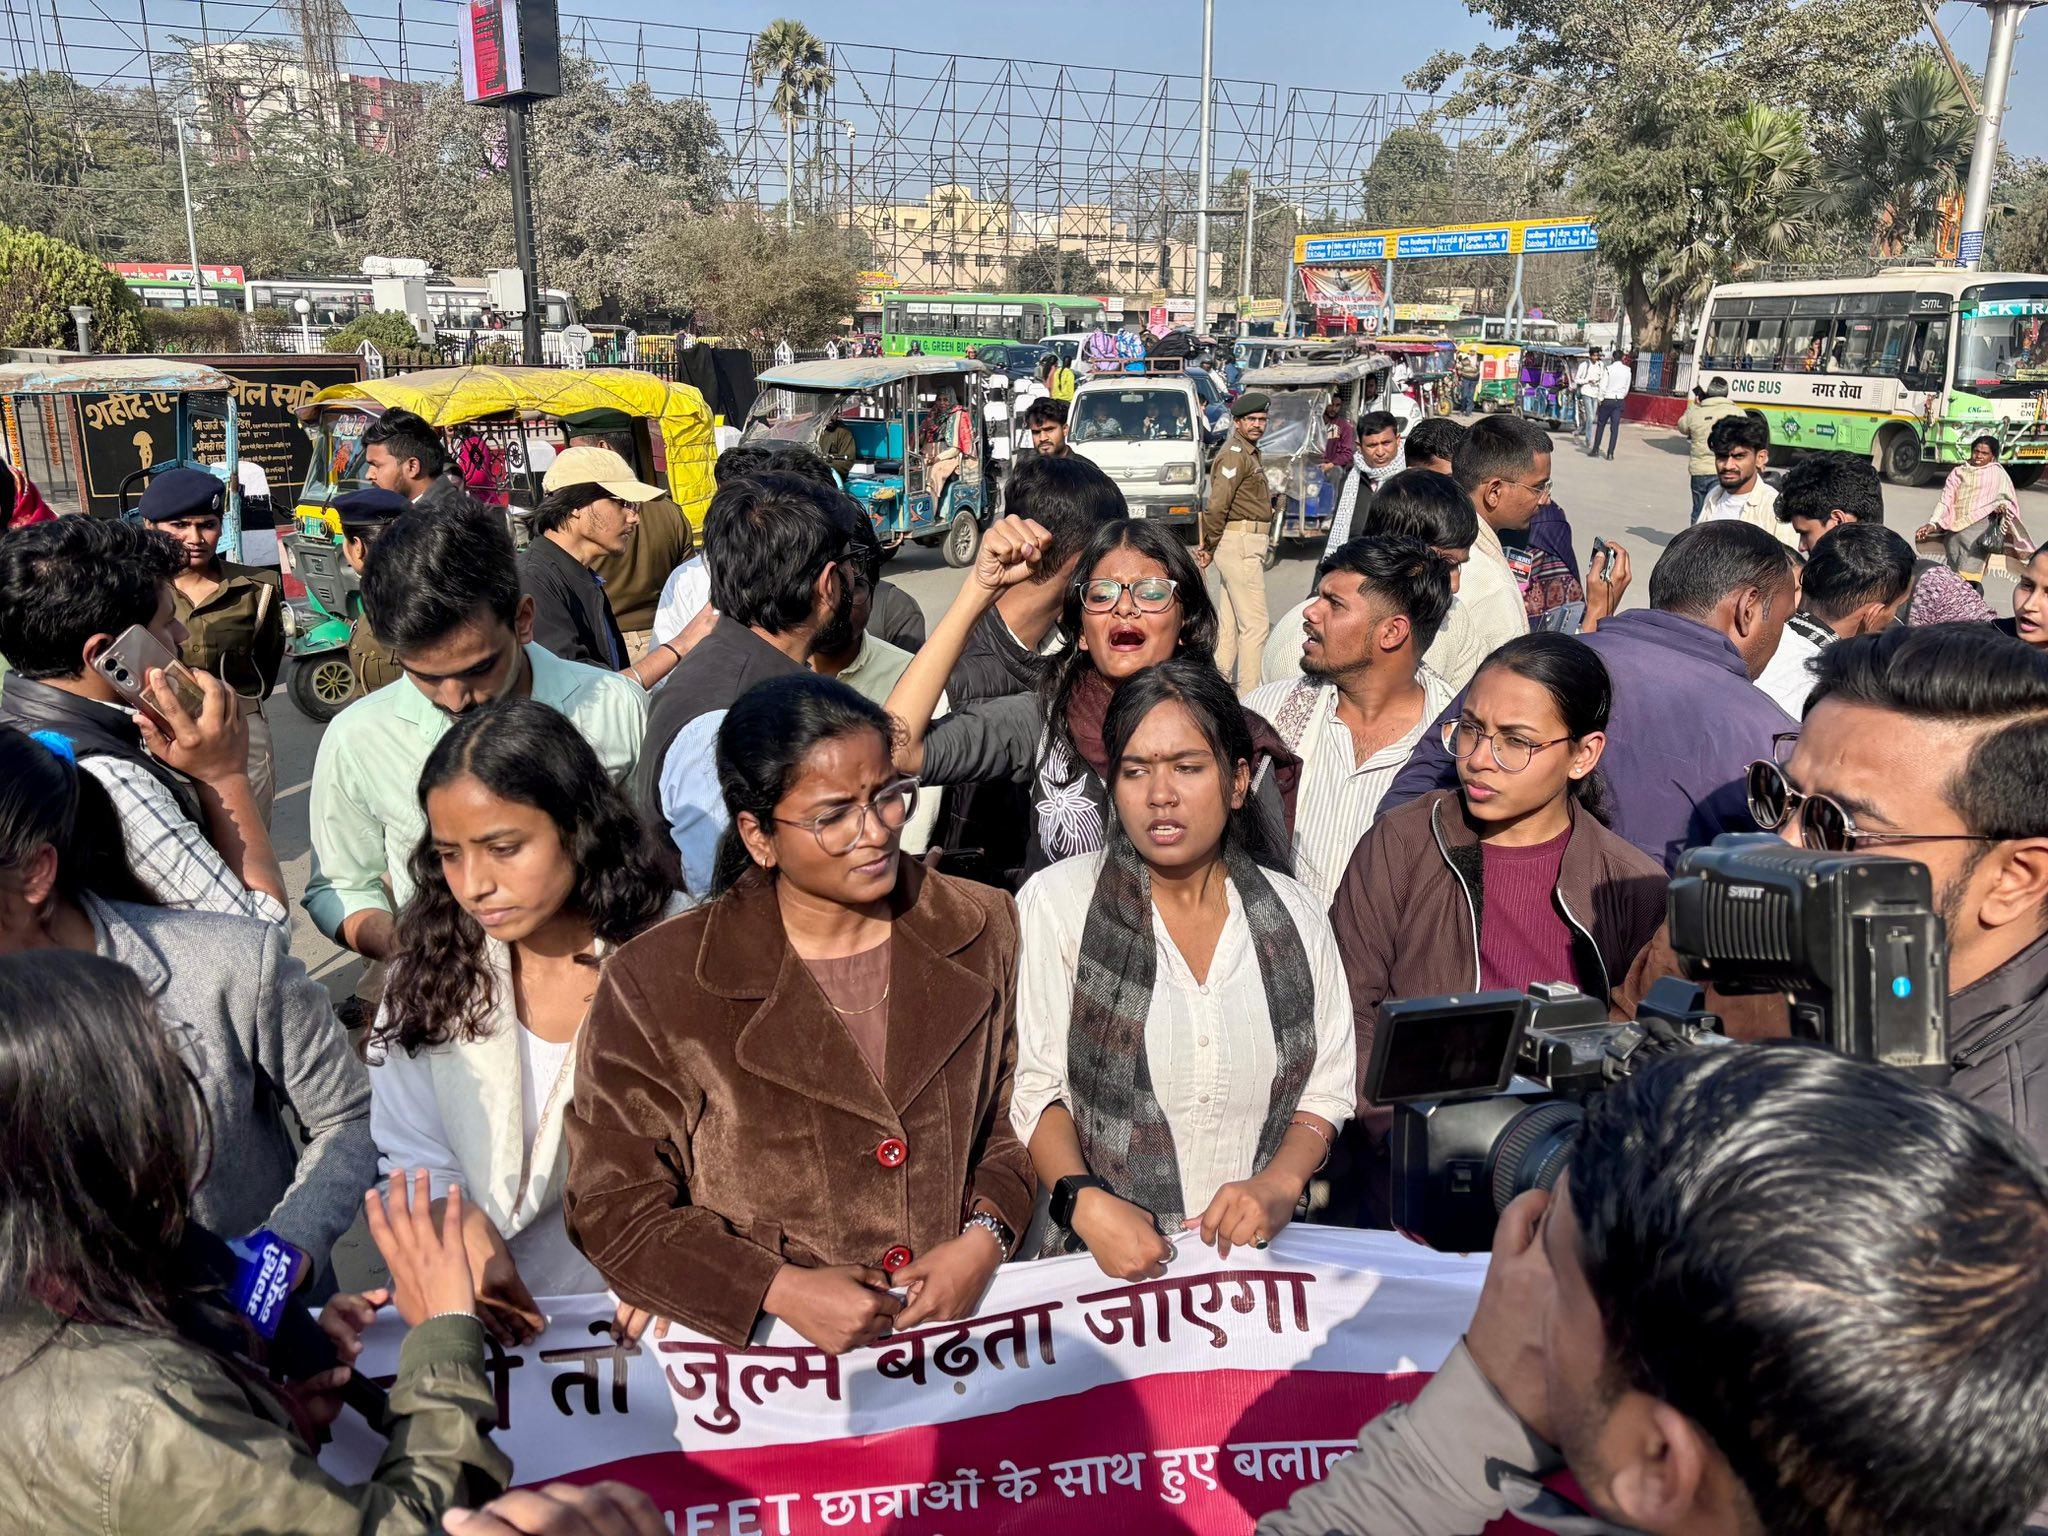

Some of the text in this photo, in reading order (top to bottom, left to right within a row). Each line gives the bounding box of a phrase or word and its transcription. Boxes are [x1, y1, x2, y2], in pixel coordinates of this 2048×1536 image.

[1920, 299, 1943, 309] SML
[932, 341, 953, 352] GREEN
[1731, 379, 1782, 395] CNG BUS
[1811, 380, 1863, 400] नगर सेवा
[1784, 425, 1798, 433] CNG
[1727, 885, 1765, 900] SWIT
[246, 1242, 280, 1316] मगही
[257, 1251, 292, 1324] न्यूज
[658, 1340, 842, 1435] जुल्म
[868, 1301, 1064, 1396] बढ़ता
[1077, 1270, 1317, 1349] जाएगा
[812, 1467, 986, 1526] छात्राओं
[992, 1459, 1041, 1503] के
[1048, 1451, 1147, 1498] साथ
[1153, 1445, 1220, 1505] हुए
[1226, 1438, 1360, 1481] बला
